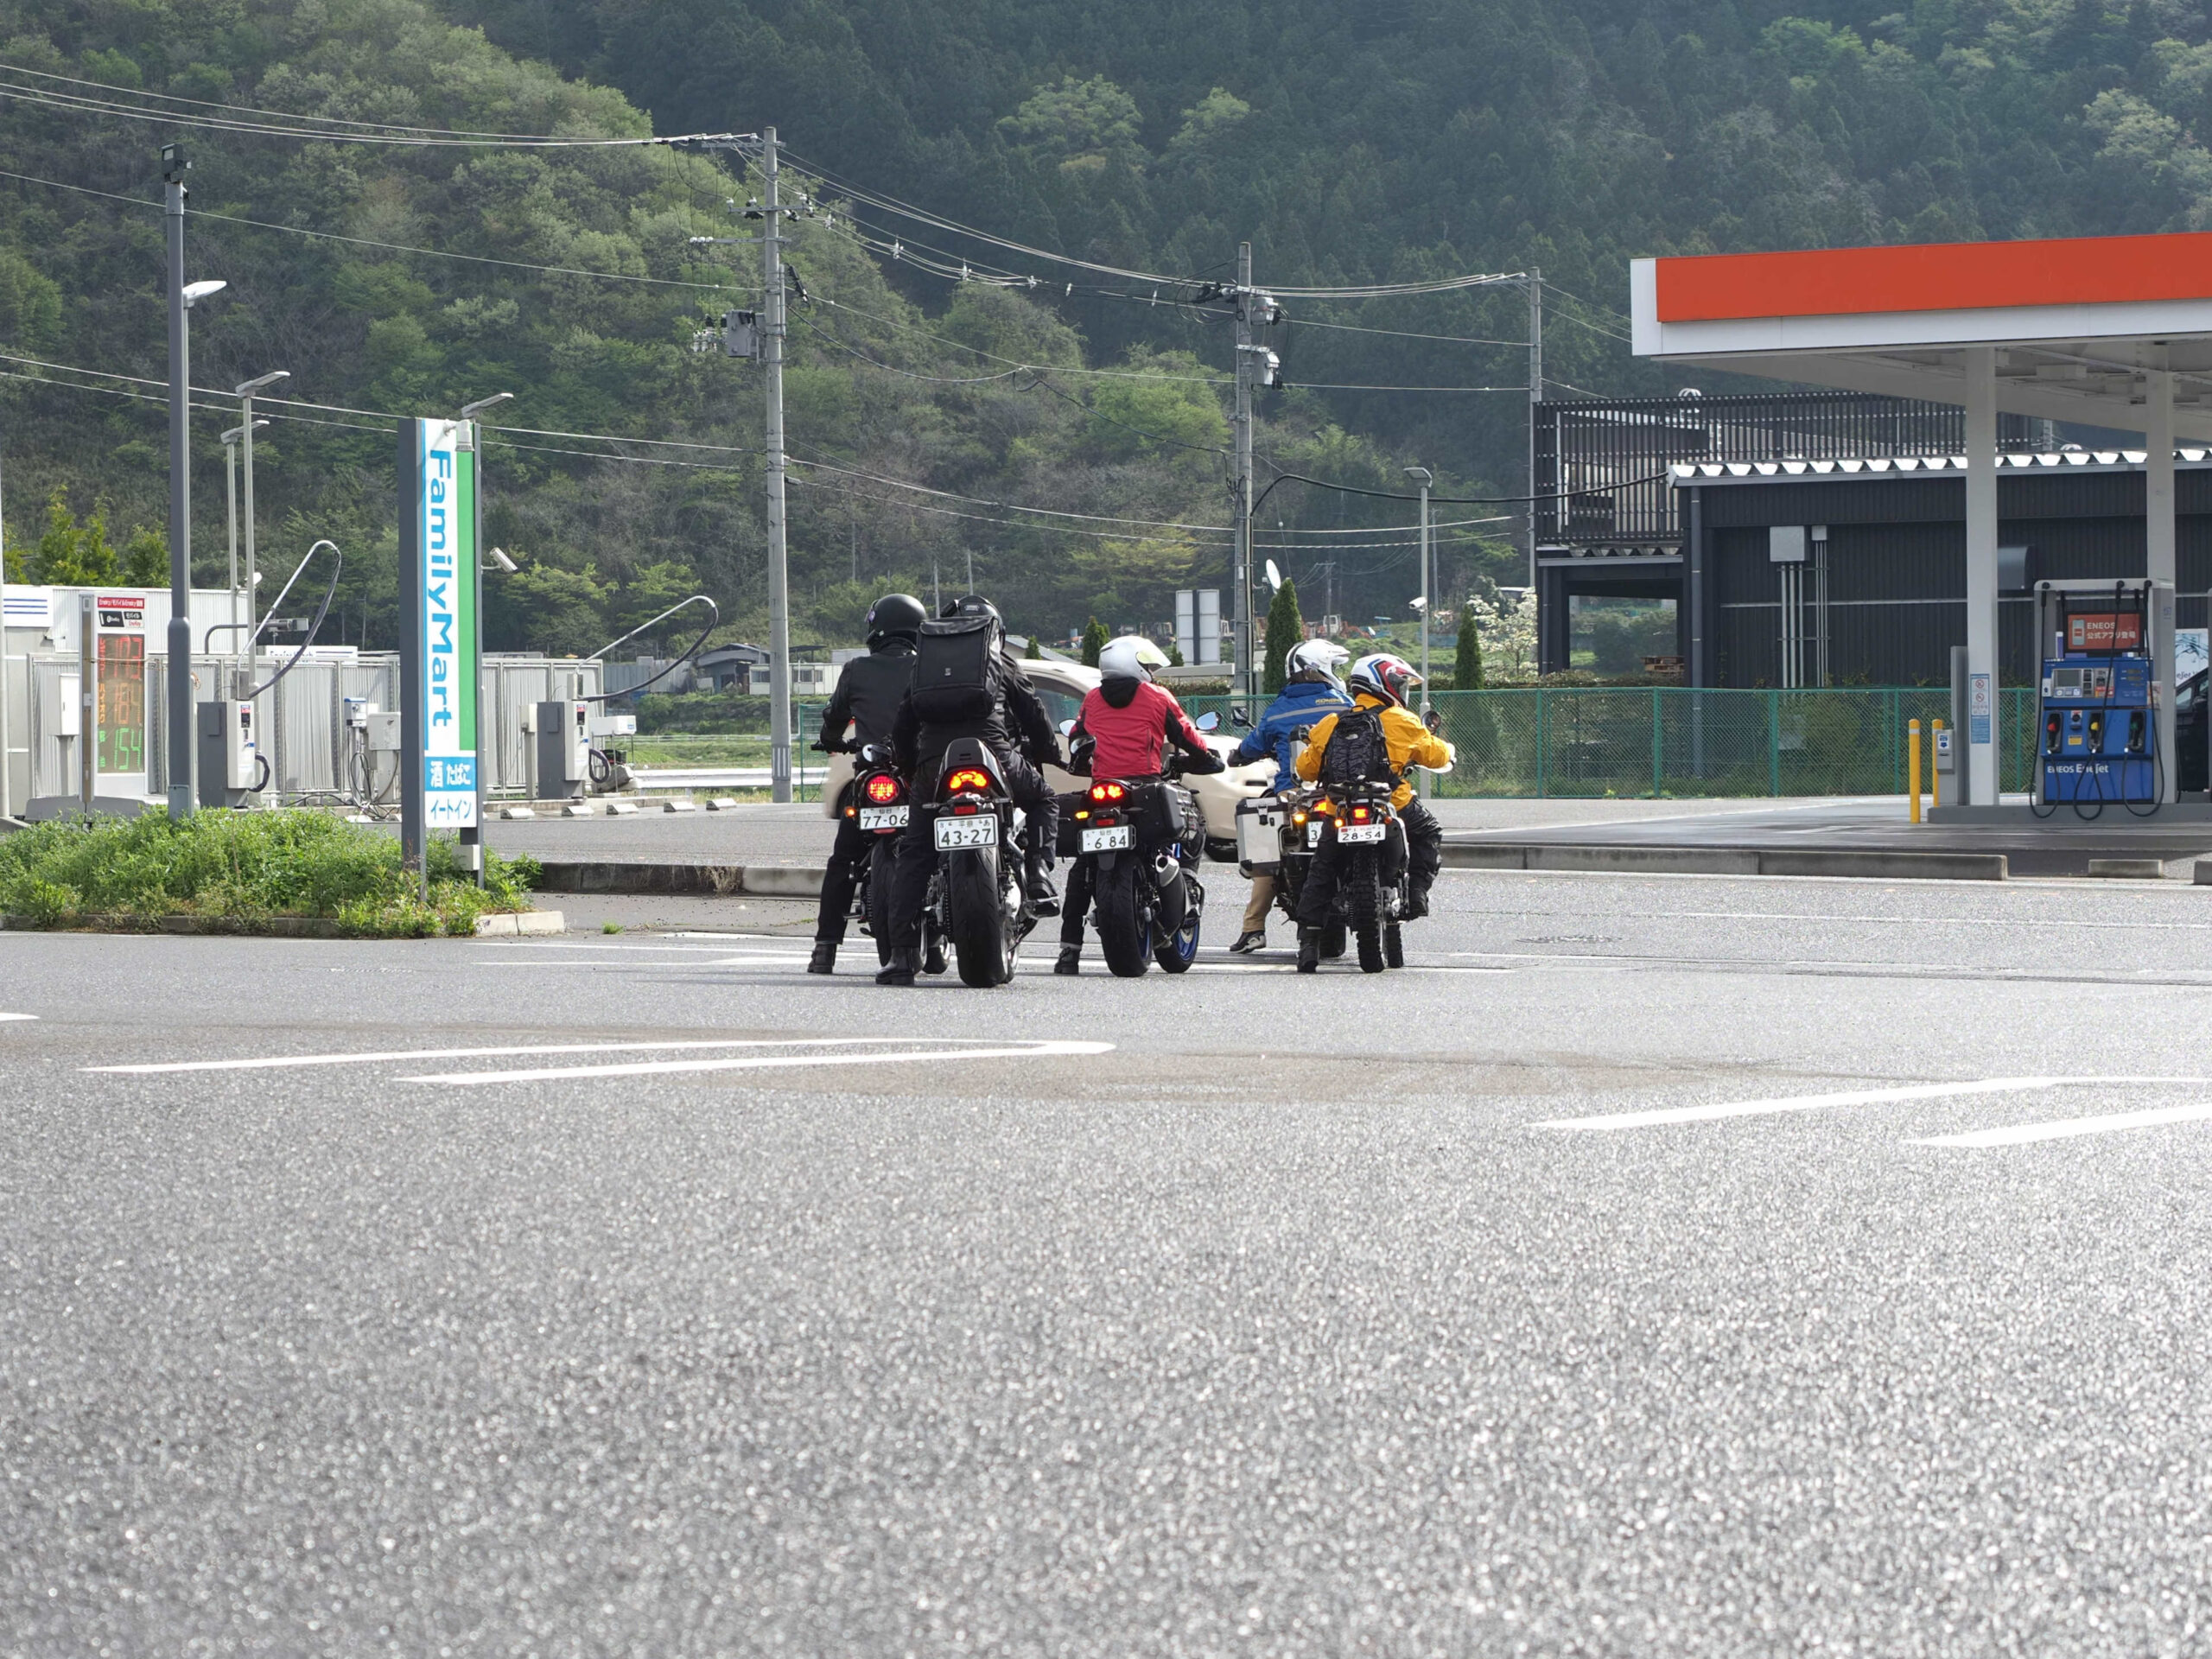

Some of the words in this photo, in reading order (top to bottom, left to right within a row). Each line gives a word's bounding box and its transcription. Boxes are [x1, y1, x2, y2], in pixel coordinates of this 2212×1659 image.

[429, 449, 453, 728] FamilyMart
[114, 728, 143, 770] 154
[430, 760, 443, 787] 酒
[446, 763, 472, 785] たばこ
[430, 798, 472, 820] イートイン
[863, 814, 908, 828] 77-06
[941, 828, 991, 846] 43-27
[1342, 830, 1382, 841] 28-54
